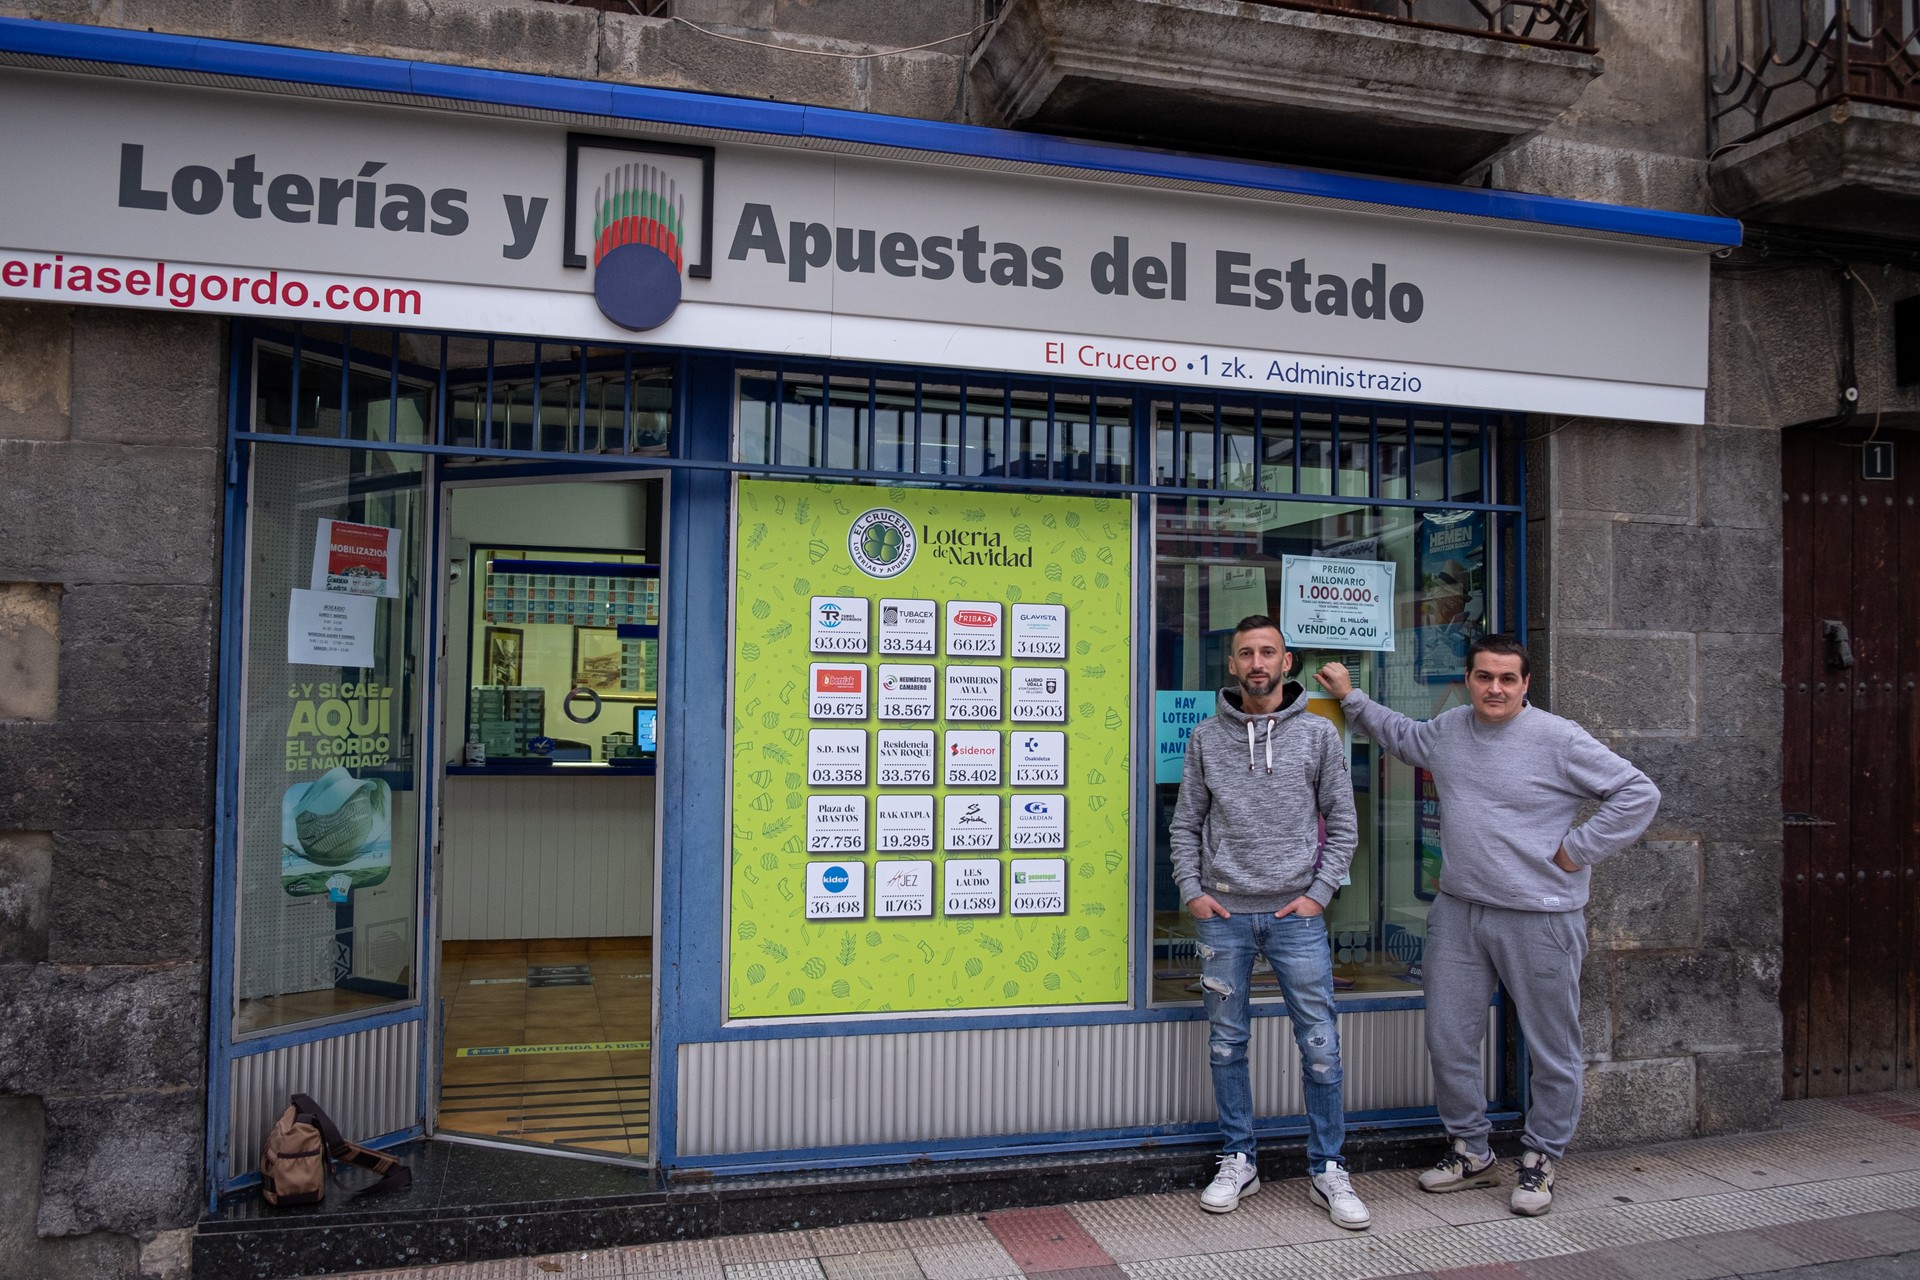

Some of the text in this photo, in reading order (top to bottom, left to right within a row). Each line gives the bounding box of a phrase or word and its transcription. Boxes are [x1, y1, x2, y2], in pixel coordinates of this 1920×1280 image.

[117, 142, 1424, 324] Loterías y Apuestas del Estado
[2, 254, 423, 317] eriaselgordo.com
[1044, 341, 1065, 365] El
[1078, 345, 1177, 374] Crucero
[1220, 355, 1254, 381] zk.
[1266, 360, 1422, 394] Administrazio
[1874, 446, 1881, 474] 1
[854, 512, 911, 539] EL CRUCERO
[923, 525, 1001, 547] Lotería
[1429, 525, 1473, 548] HEMEN
[330, 543, 388, 558] MOBILIZAZIOA
[932, 545, 1033, 568] de Navidad
[886, 543, 912, 574] APUESTAS
[1322, 565, 1356, 575] PREMIO
[1311, 575, 1366, 587] MILLONARIO
[1298, 584, 1379, 603] 1.000.000 €
[899, 610, 934, 618] TUBACEX
[958, 611, 993, 623] FRIBASA
[1348, 616, 1369, 624] MILLÓN
[1297, 623, 1377, 638] VENDIDO AQUÍ
[815, 637, 867, 650] 93.050
[883, 638, 932, 652] 33.544
[953, 638, 996, 652] 66.123
[1017, 641, 1061, 654] 34.932
[949, 676, 998, 685] BOMBEROS
[287, 682, 380, 699] ¿Y SI CAE
[960, 686, 987, 694] AYALA
[814, 702, 864, 716] 09.675
[884, 703, 932, 716] 18.567
[1175, 697, 1197, 709] HAY
[286, 687, 394, 740] AQUÍ
[949, 705, 997, 718] 76.306
[1013, 705, 1063, 717] 09.503
[1162, 711, 1208, 724] LOTERIA
[1178, 727, 1191, 739] DE
[286, 736, 390, 757] EL GORDO
[816, 745, 860, 754] S.D. ISASI
[883, 740, 928, 748] Residencia
[960, 746, 996, 755] sidenor
[1160, 742, 1186, 754] NAVI
[880, 749, 931, 758] SAN ROQUE
[286, 754, 390, 771] DE NAVIDAD?
[812, 769, 863, 782] 03.358
[882, 769, 931, 782] 33.576
[949, 769, 997, 782] 58.402
[1017, 768, 1059, 781] 13.303
[818, 804, 856, 813] Plaza de
[880, 811, 930, 819] RAKATAPLA
[816, 814, 859, 823] ABASTOS
[811, 835, 862, 849] 27.756
[882, 835, 930, 848] 19.295
[952, 834, 993, 847] 18.567
[1014, 832, 1061, 845] 92.508
[823, 875, 848, 884] kider
[900, 874, 918, 887] JEZ
[956, 878, 990, 886] LAUDIO
[810, 900, 860, 914] 36.498
[885, 899, 922, 912] 11.765
[949, 897, 996, 910] 04.589
[1014, 896, 1062, 910] 09.675
[514, 1043, 592, 1053] MANTENGA
